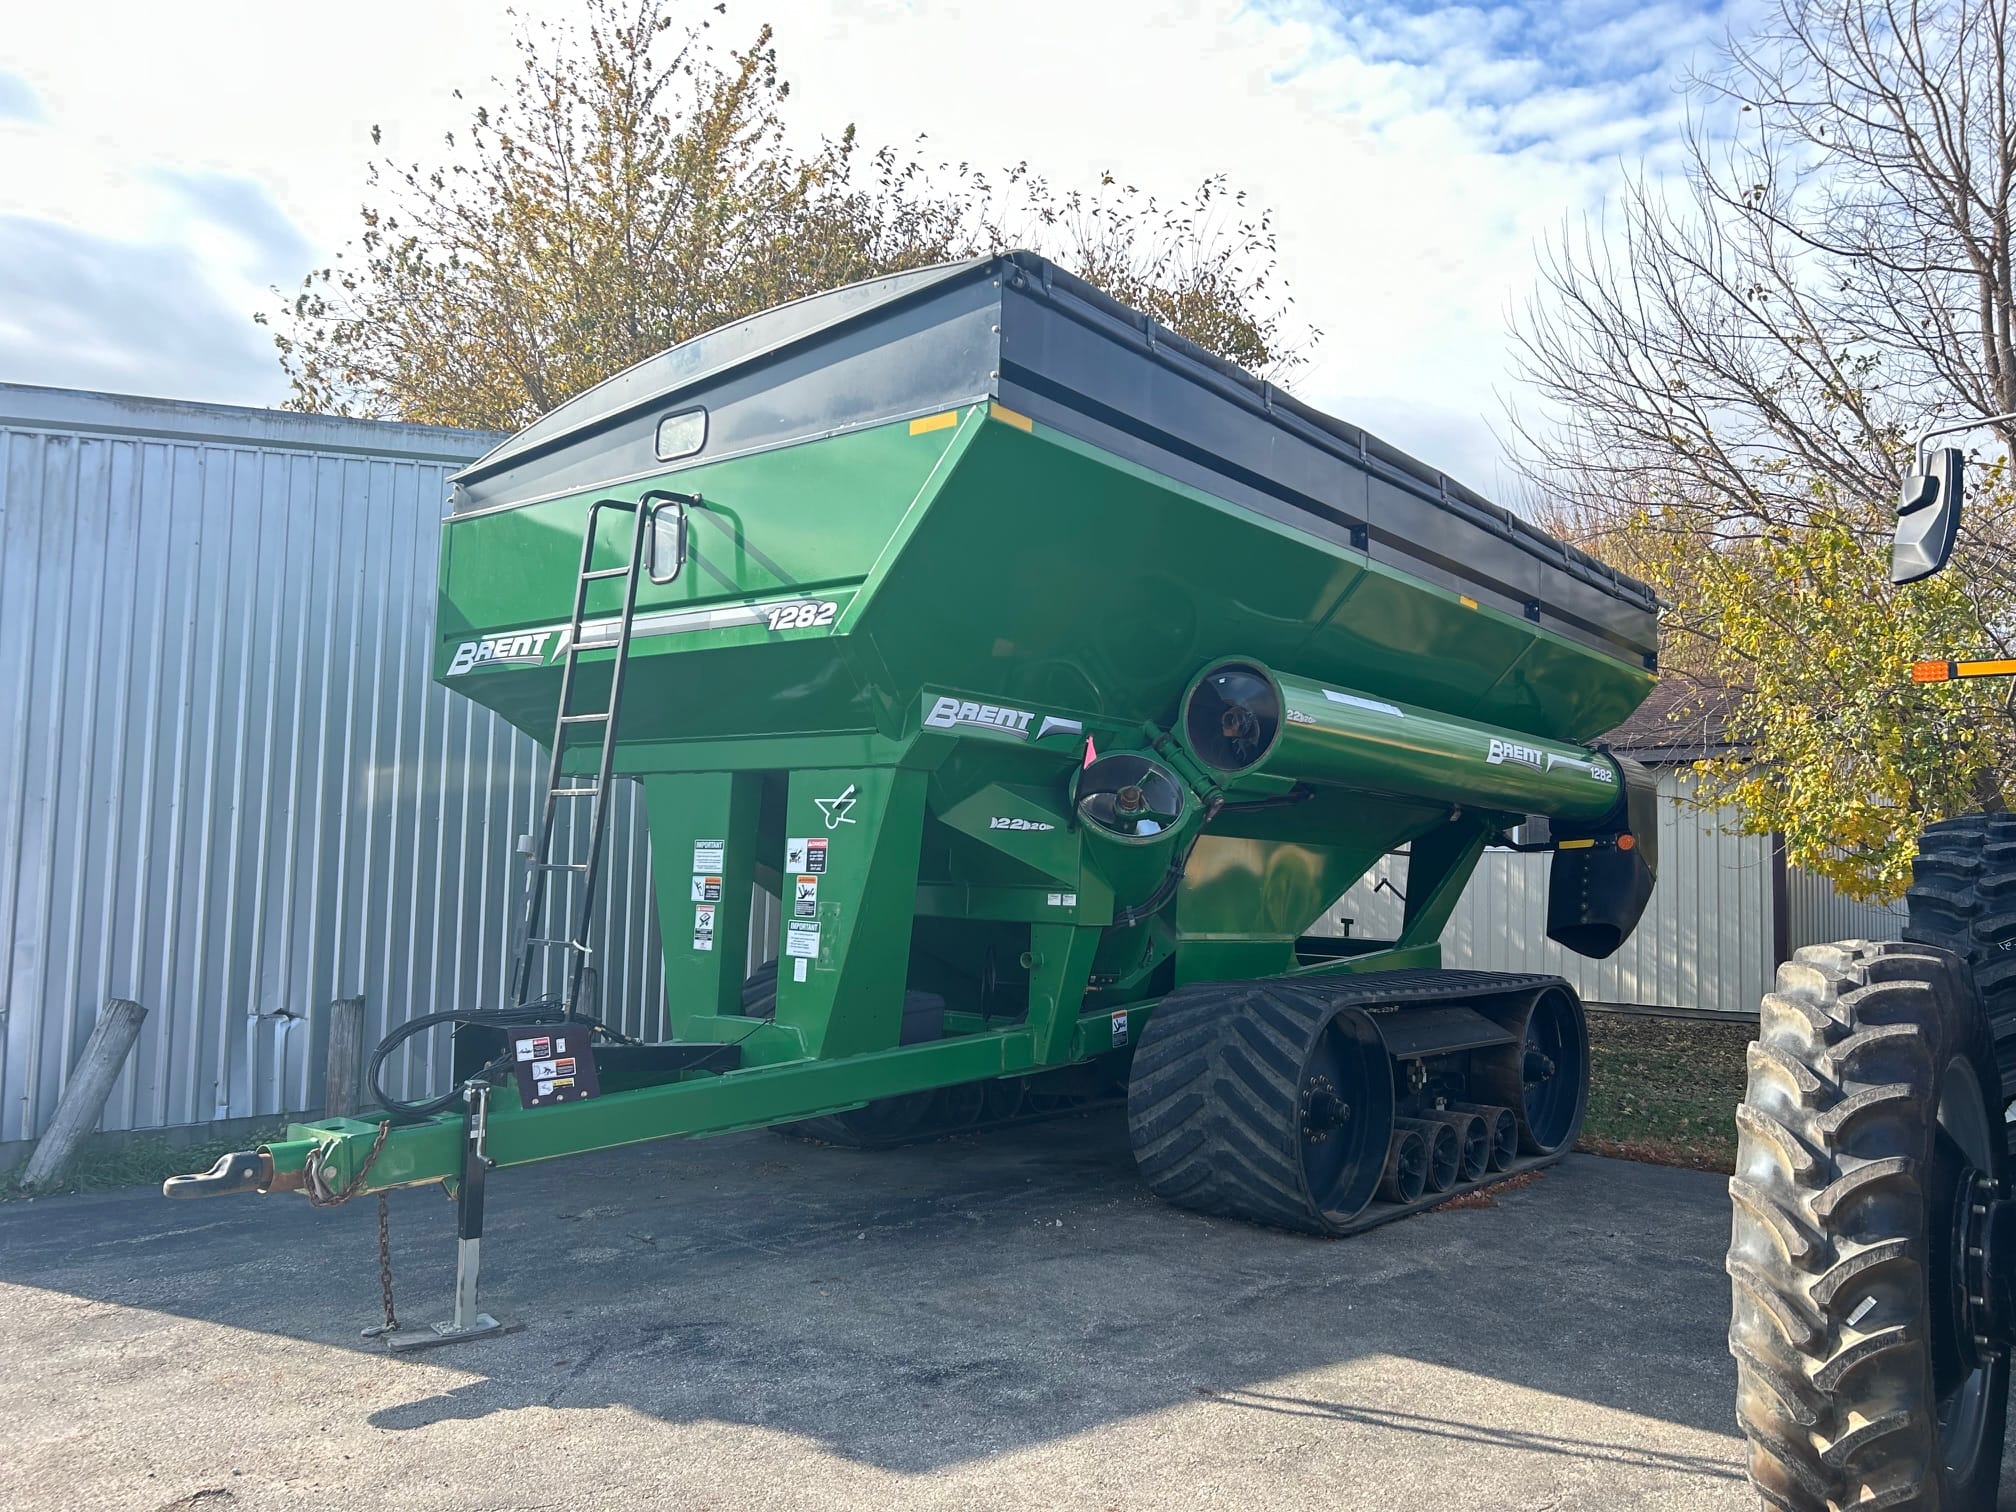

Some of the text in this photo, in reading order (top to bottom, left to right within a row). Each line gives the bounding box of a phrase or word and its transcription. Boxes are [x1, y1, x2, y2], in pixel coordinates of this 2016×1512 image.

[768, 601, 838, 631] 1282
[446, 632, 552, 676] BRENT
[924, 696, 1035, 730] BRENT
[1486, 738, 1543, 766] BRENT
[1590, 766, 1613, 783] 1282
